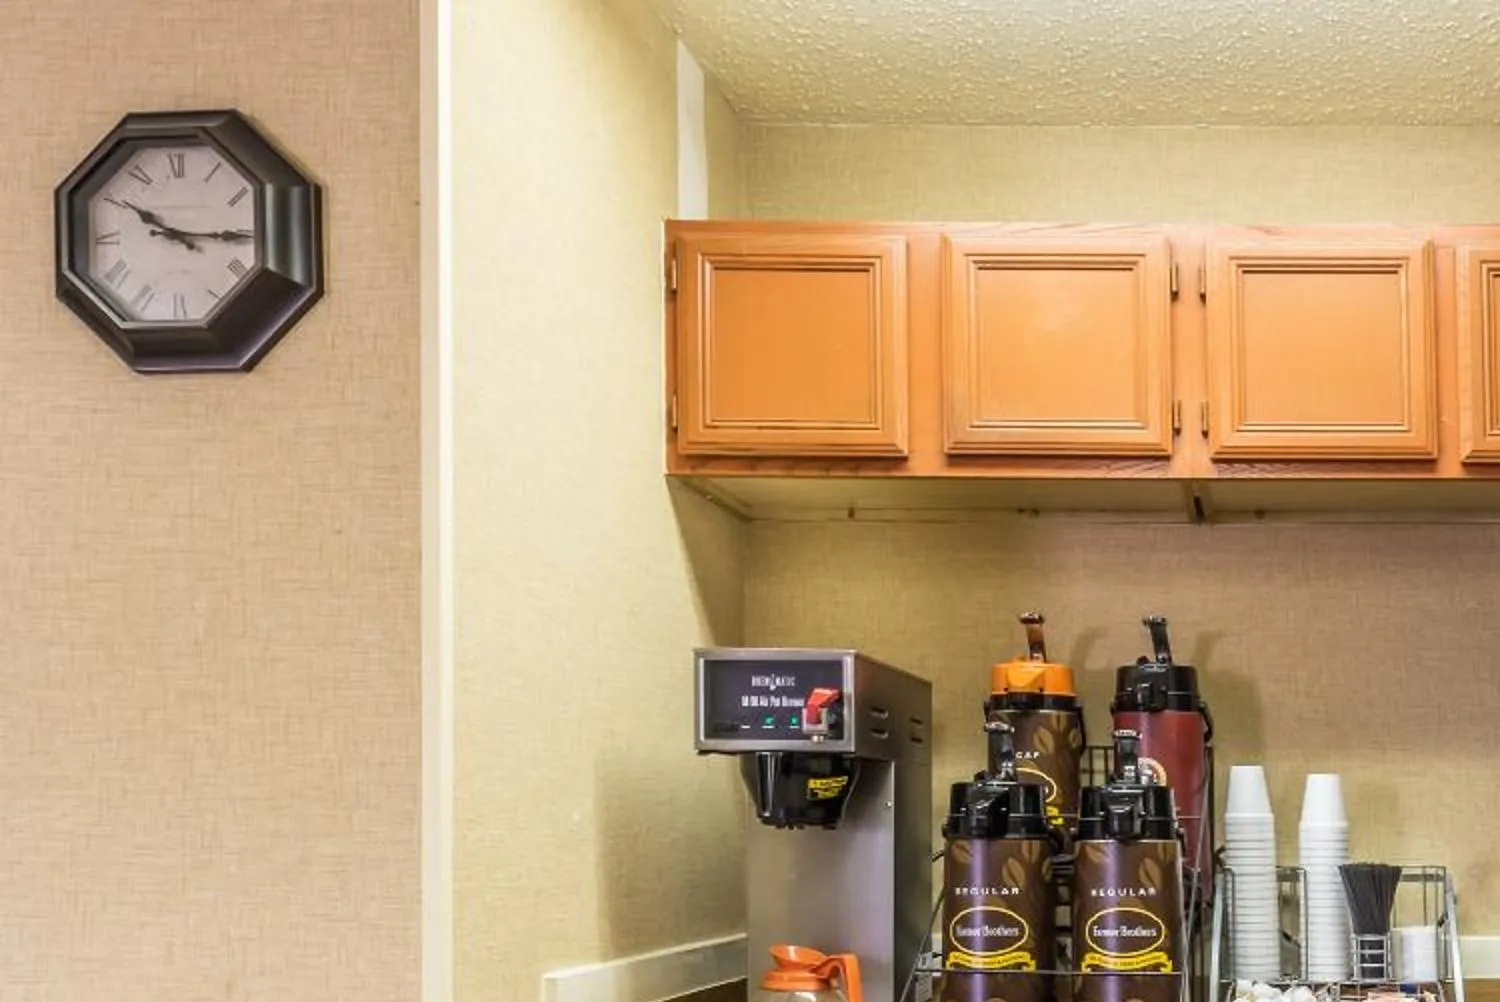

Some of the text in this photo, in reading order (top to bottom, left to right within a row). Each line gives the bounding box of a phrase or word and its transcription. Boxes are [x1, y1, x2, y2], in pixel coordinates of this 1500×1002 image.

[1015, 751, 1041, 760] CAF
[954, 886, 1020, 896] REGULAR
[1091, 887, 1157, 897] REGULAR
